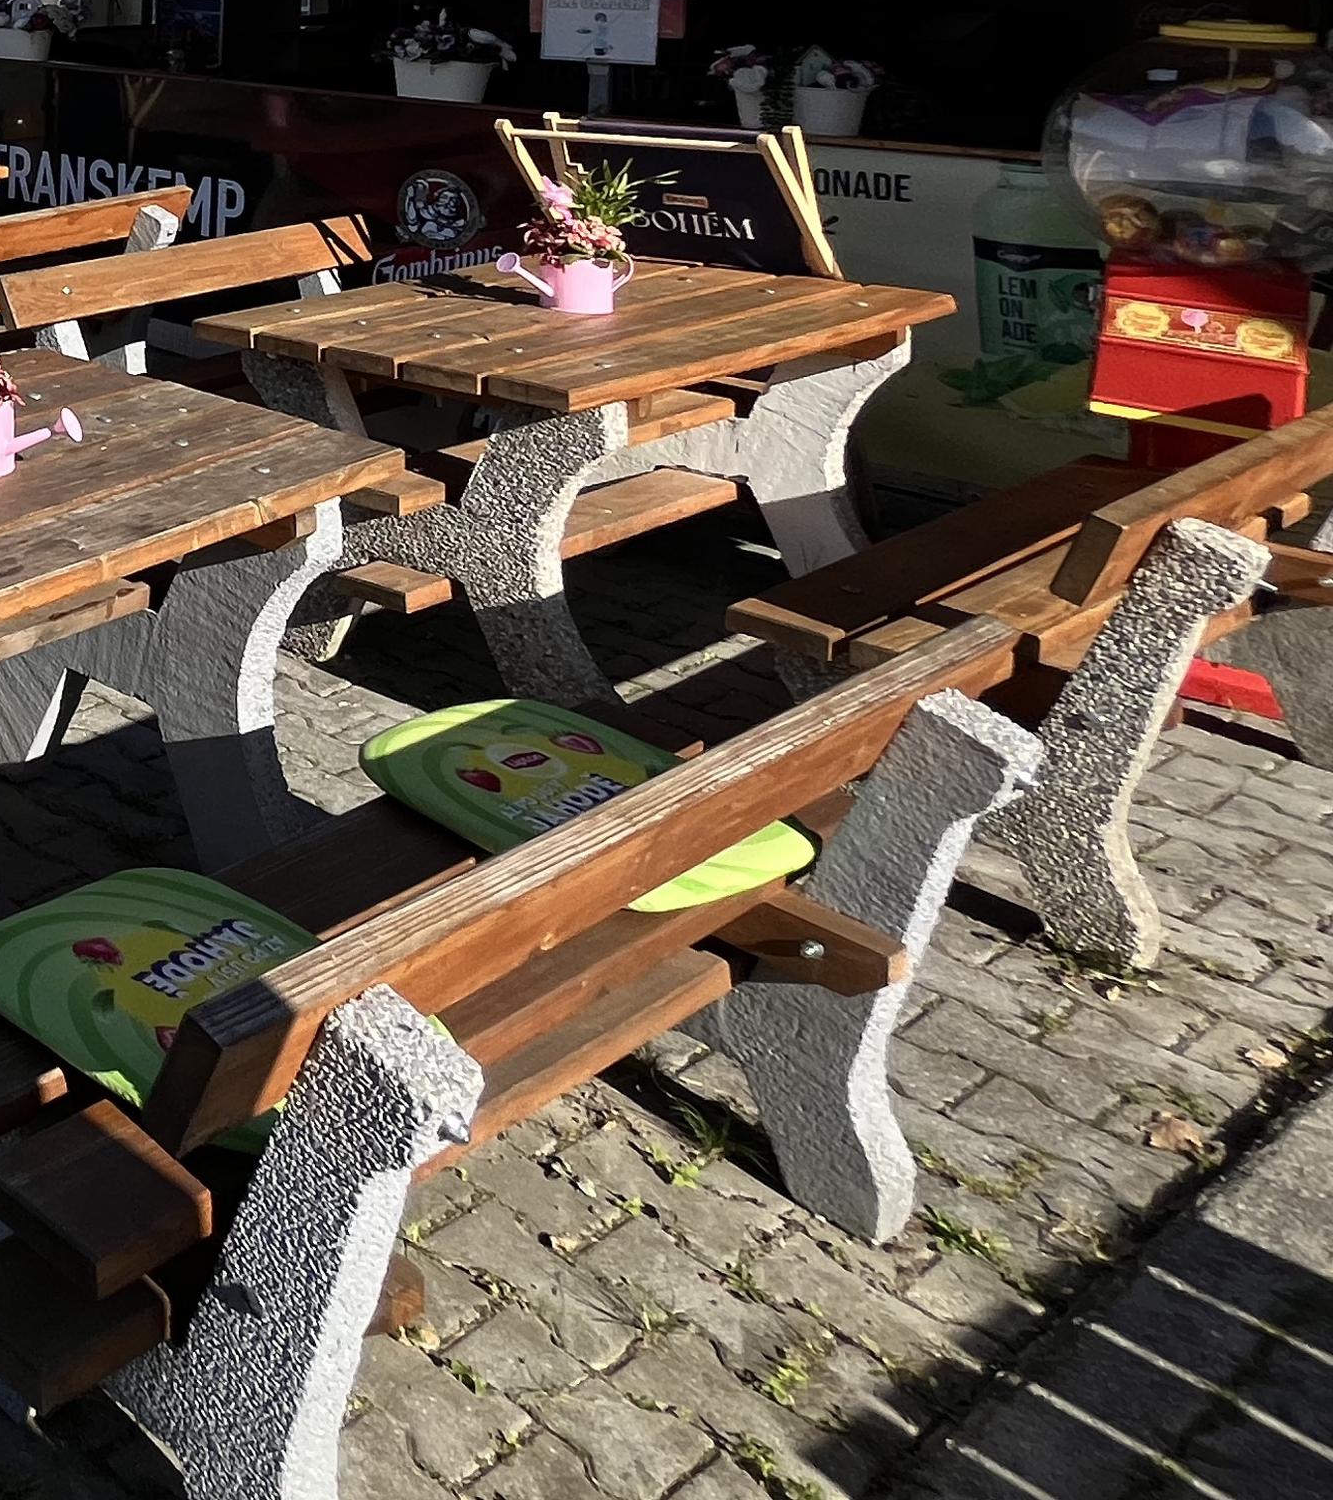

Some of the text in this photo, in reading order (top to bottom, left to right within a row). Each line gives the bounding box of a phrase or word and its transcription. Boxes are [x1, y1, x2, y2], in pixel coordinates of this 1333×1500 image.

[814, 168, 913, 202] ONADE
[998, 275, 1037, 299] LEM
[999, 297, 1023, 319] ON
[1002, 320, 1037, 343] ADE
